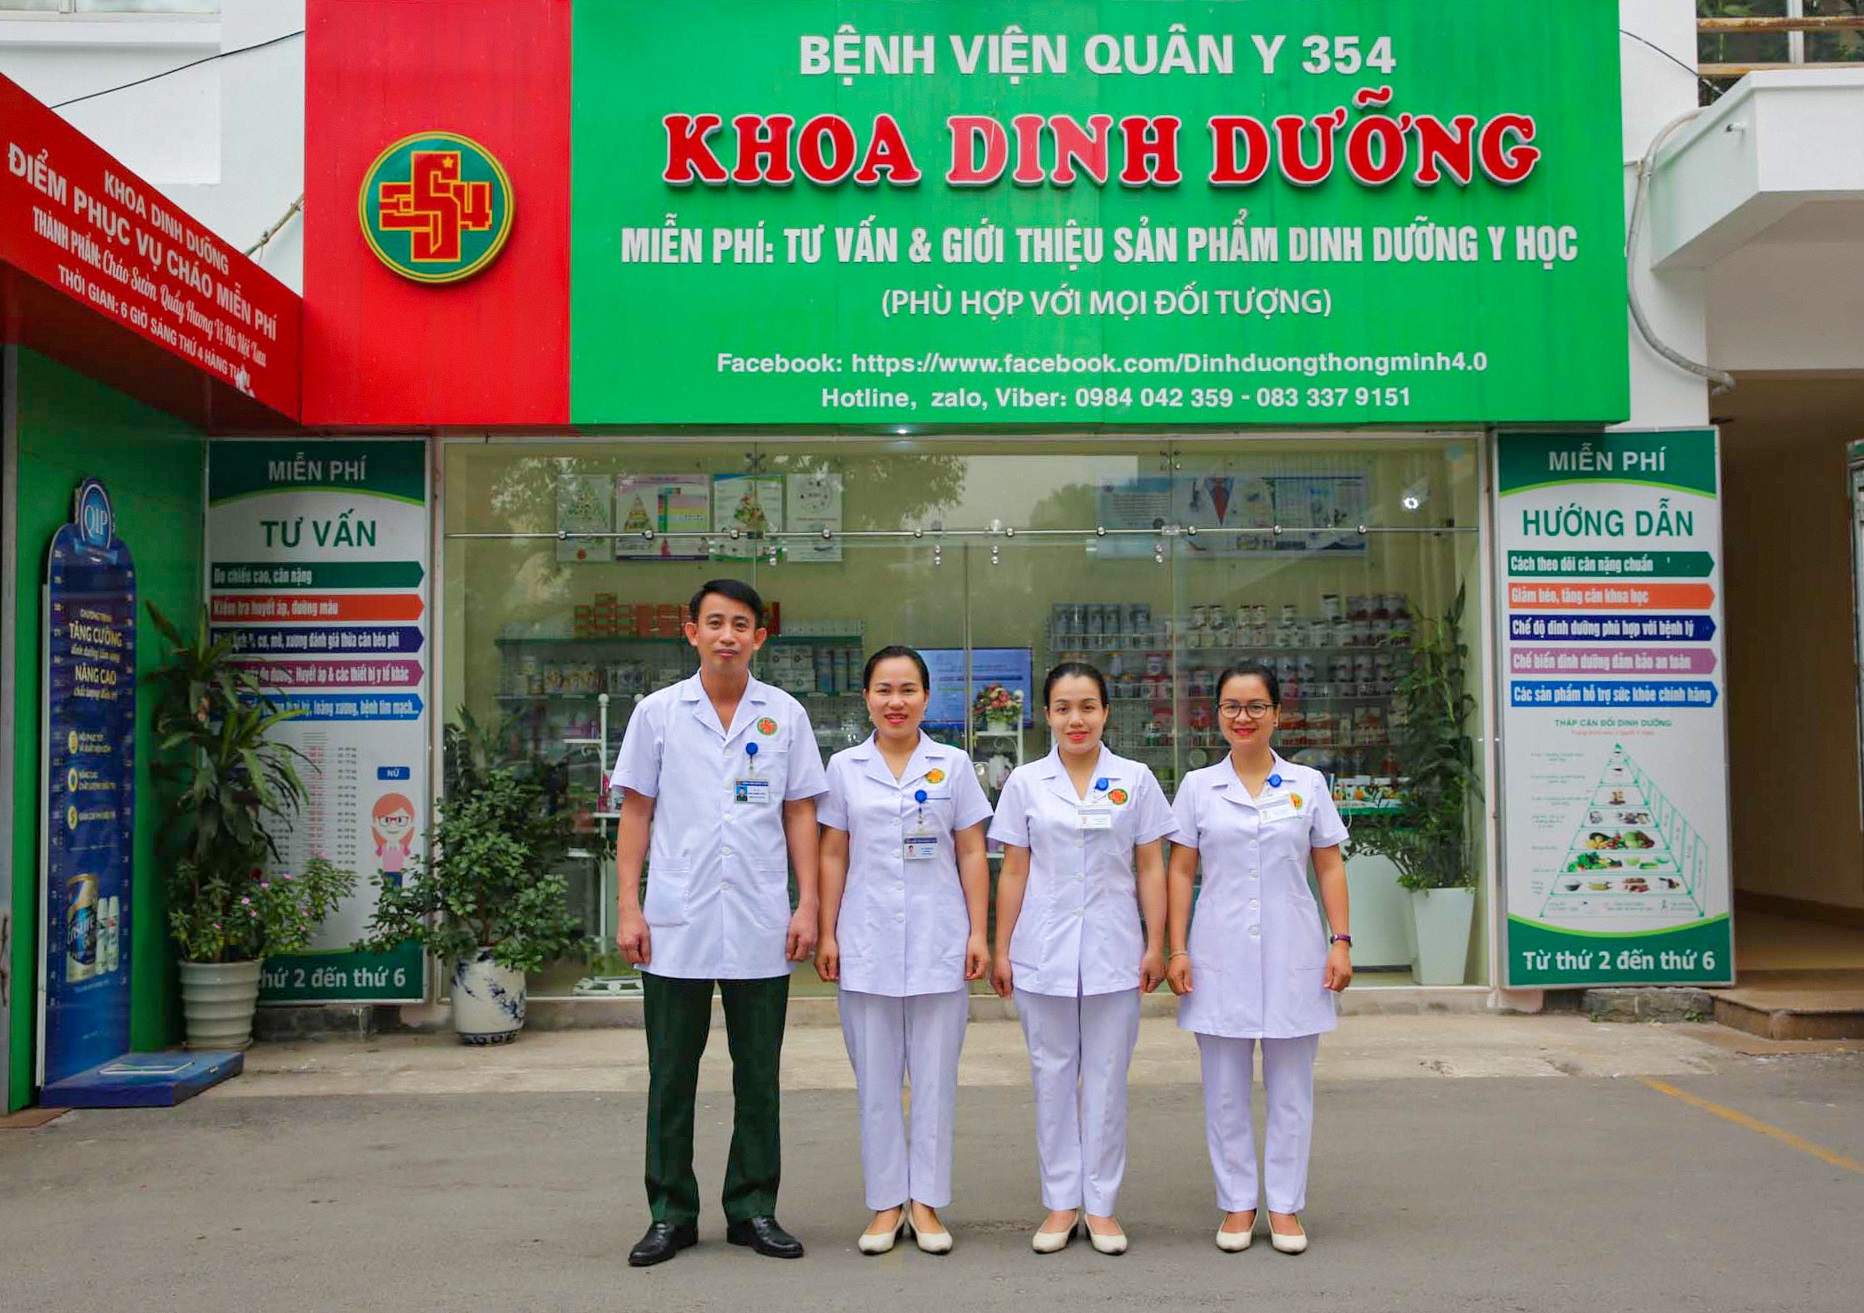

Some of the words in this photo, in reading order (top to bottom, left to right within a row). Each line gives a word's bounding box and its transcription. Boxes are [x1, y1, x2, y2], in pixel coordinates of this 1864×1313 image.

[800, 24, 935, 86] BỆNH
[949, 24, 1066, 86] VIỆN
[1084, 23, 1233, 76] QUÂN
[1251, 35, 1286, 74] Y
[1302, 35, 1396, 75] 354
[662, 113, 922, 187] KHOA
[946, 113, 1182, 187] DINH
[1207, 85, 1541, 187] DƯỠNG
[104, 169, 147, 219] KHOA
[151, 203, 183, 244] DINH
[186, 227, 229, 276] DƯỠNG
[8, 141, 67, 206] ĐIỂM
[73, 186, 131, 246] PHỤC
[136, 227, 161, 272] VỤ
[167, 249, 213, 299] CHÁO
[217, 281, 251, 325] MIỄN
[255, 308, 277, 342] PHÍ
[33, 205, 69, 251] THÀNH
[71, 230, 101, 269] PHẦN:
[103, 249, 129, 284] Cháo
[621, 213, 702, 264] MIỄN
[712, 221, 774, 264] PHÍ:
[783, 224, 825, 264] TƯ
[835, 214, 898, 264] VẤN
[909, 228, 932, 264] &
[942, 217, 1004, 264] GIỚI
[1016, 219, 1104, 271] THIỆU
[1114, 216, 1178, 263] SẢN
[1187, 208, 1279, 263] PHẨM
[1289, 226, 1362, 263] DINH
[1373, 214, 1479, 263] DƯỠNG
[1486, 226, 1507, 262] Y
[1516, 225, 1579, 270] HỌC
[881, 284, 953, 319] (PHÙ
[961, 287, 1024, 323] HỢP
[1030, 283, 1080, 317] VỚI
[1088, 288, 1144, 321] MỌI
[1154, 281, 1209, 316] ĐỐI
[1215, 287, 1333, 321] TƯỢNG)
[58, 264, 85, 295] THỜI
[88, 282, 118, 314] GIAN:
[121, 302, 128, 318] 6
[130, 306, 148, 329] GIỜ
[151, 317, 177, 346] SÁNG
[179, 334, 197, 357] THỨ
[205, 348, 228, 375] HÀNG
[717, 352, 843, 374] Facebook:
[851, 352, 1488, 377] https://www.facebook.com/Dinhduongthongminh4.0
[821, 388, 917, 411] Hotline,
[931, 388, 988, 411] zalo,
[996, 388, 1067, 408] Viber:
[1075, 388, 1133, 408] 0984
[1140, 388, 1183, 407] 042
[1190, 388, 1234, 407] 359
[1256, 388, 1299, 407] 083
[1306, 388, 1349, 407] 337
[1354, 387, 1410, 407] 9151
[268, 451, 322, 482] MIỄN
[329, 454, 367, 481] PHÍ
[1548, 442, 1613, 471] MIỄN
[1622, 446, 1667, 471] PHÍ
[261, 516, 303, 548] TƯ
[312, 508, 376, 547] VẤN
[1522, 503, 1624, 537] HƯỚNG
[1636, 498, 1694, 537] DẪN
[273, 567, 289, 583] cân
[291, 567, 312, 586] nặng
[1511, 555, 1535, 571] Cách
[1537, 556, 1558, 571] theo
[1578, 556, 1596, 571] cân
[1598, 556, 1622, 575] nặng
[1584, 587, 1603, 603] cân
[1630, 588, 1649, 607] học
[1512, 617, 1532, 635] Chế
[1533, 619, 1546, 638] độ
[1570, 620, 1600, 637] dưỡng
[1602, 619, 1620, 637] phù
[1622, 620, 1640, 639] hợp
[1642, 619, 1657, 635] với
[1659, 619, 1683, 639] bệnh
[1684, 619, 1694, 637] lý
[1513, 651, 1533, 669] Chế
[1514, 686, 1533, 702] Các
[1534, 684, 1552, 701] sản
[1597, 686, 1611, 705] trợ
[1522, 948, 1550, 970] Từ
[1556, 948, 1593, 970] thứ
[1599, 952, 1611, 969] 2
[1616, 947, 1653, 970] đến
[1660, 946, 1697, 969] thứ
[1702, 951, 1715, 970] 6
[294, 969, 306, 987] 2
[311, 966, 347, 987] đến
[353, 966, 389, 987] thứ
[394, 968, 406, 987] 6
